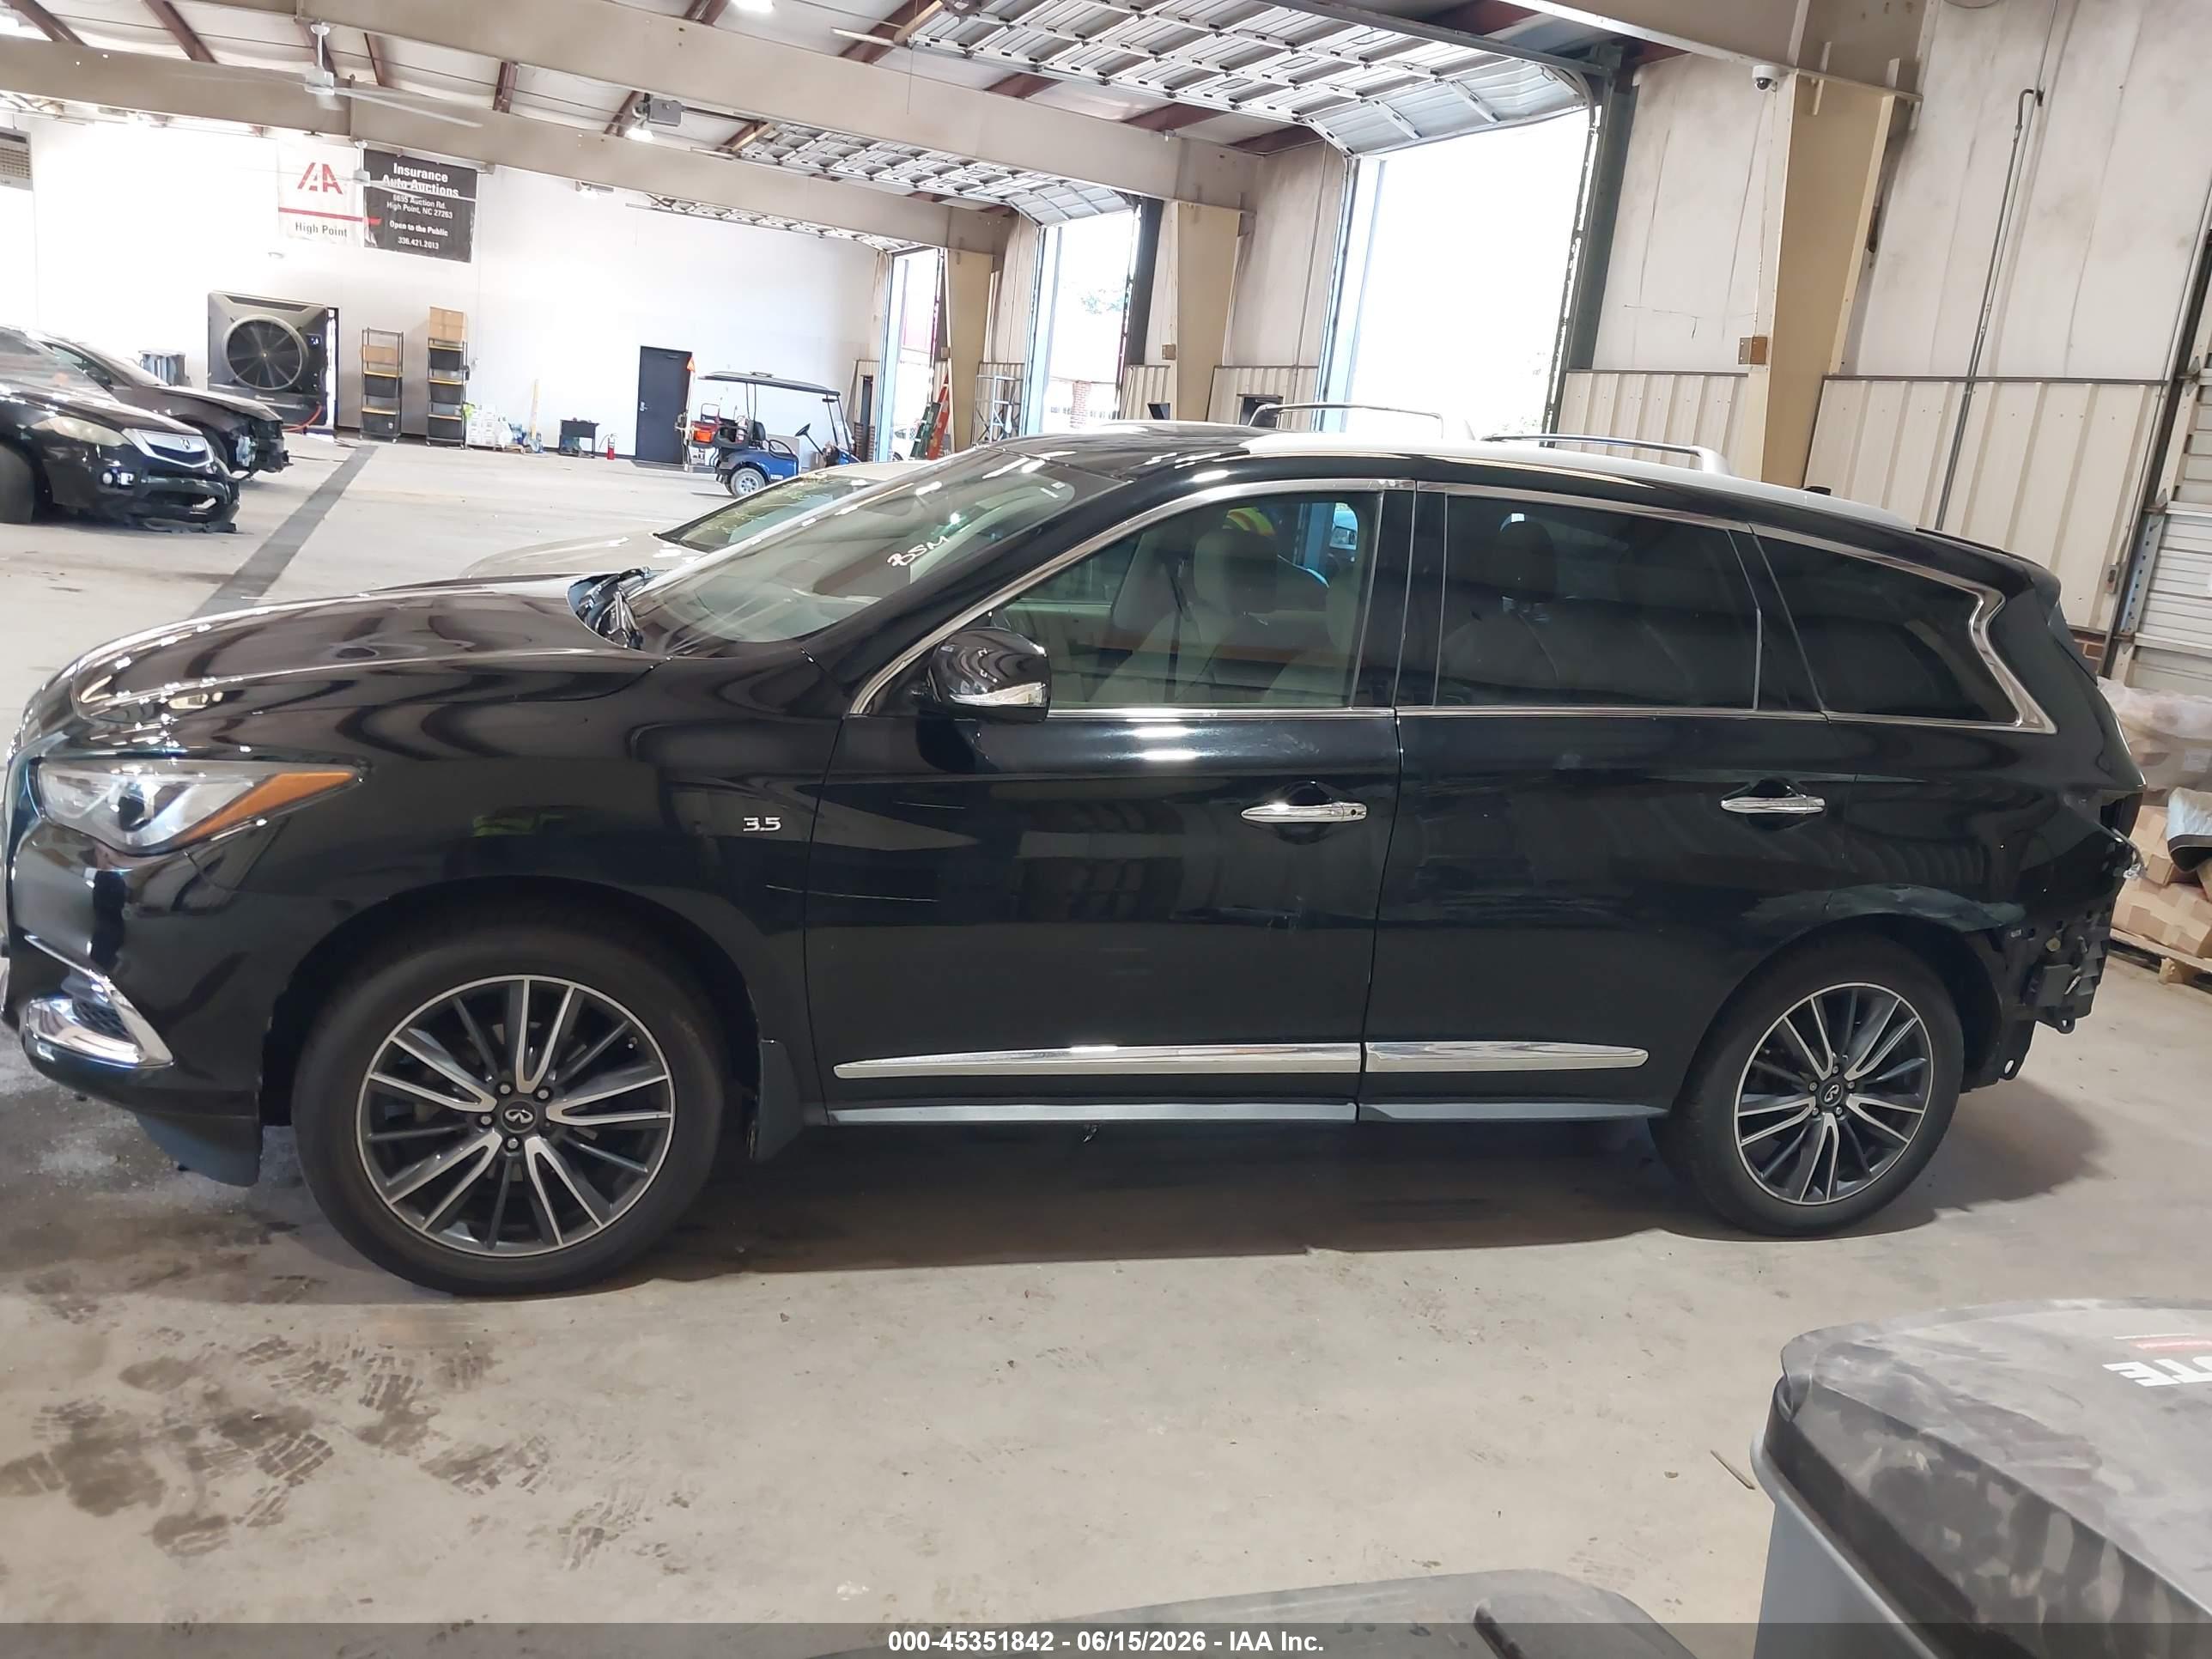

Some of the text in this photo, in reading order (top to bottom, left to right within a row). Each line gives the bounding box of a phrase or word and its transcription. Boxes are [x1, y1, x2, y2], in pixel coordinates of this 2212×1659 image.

[393, 162, 448, 183] Insurance
[382, 174, 459, 198] Auto Auctions
[386, 202, 402, 212] High
[403, 204, 421, 214] Point,
[422, 207, 433, 216] NC
[410, 197, 435, 207] Auction
[435, 201, 447, 210] Rd.
[295, 222, 348, 238] High Point
[389, 220, 407, 229] Open
[416, 224, 426, 234] the
[427, 226, 448, 236] Public
[743, 817, 781, 832] 3.5
